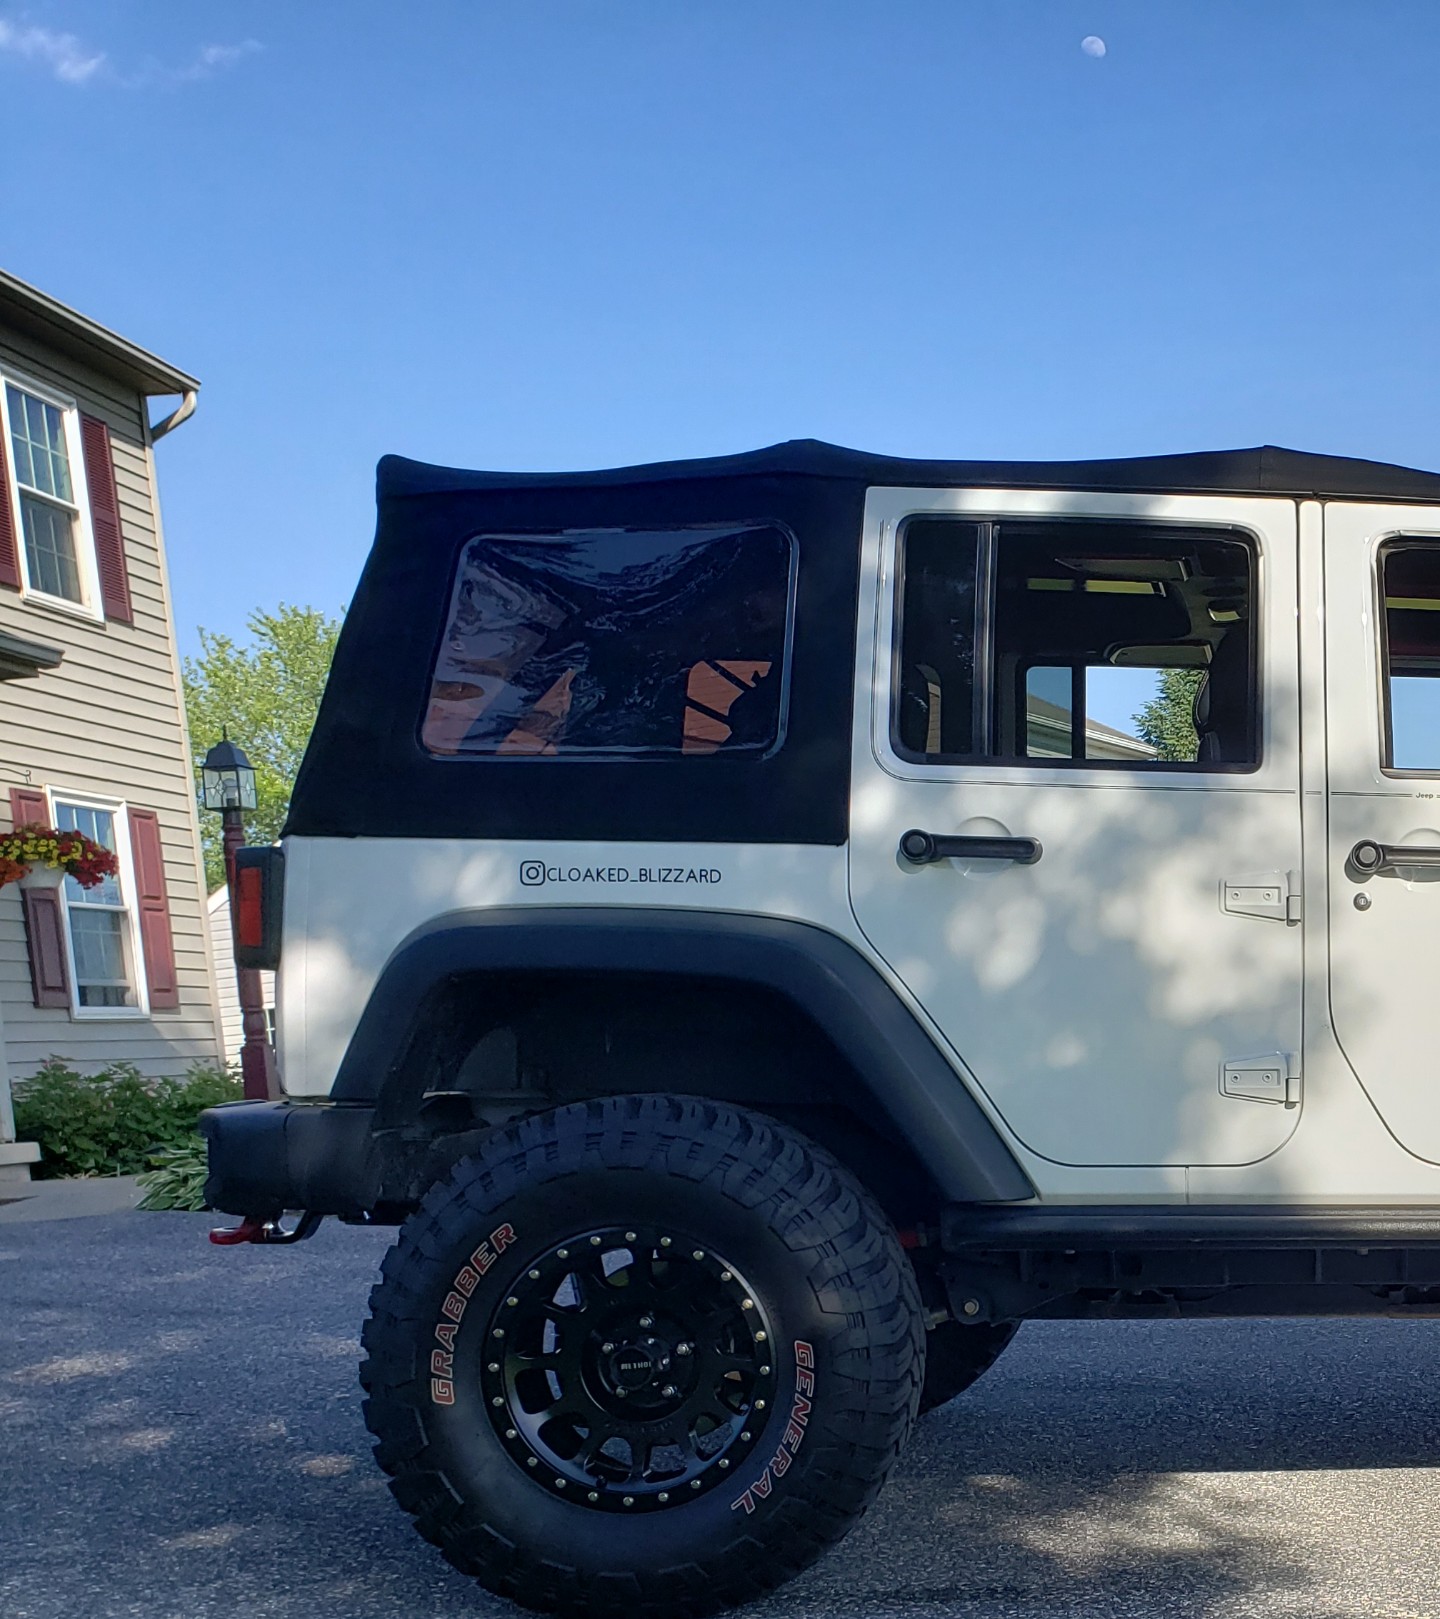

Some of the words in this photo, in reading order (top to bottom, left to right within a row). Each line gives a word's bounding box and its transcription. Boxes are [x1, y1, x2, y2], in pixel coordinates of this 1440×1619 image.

[1415, 791, 1434, 800] Jeep
[546, 867, 722, 884] CLOAKED_BLIZZARD
[431, 1222, 518, 1405] GRABBER
[731, 1340, 815, 1514] GENERAL
